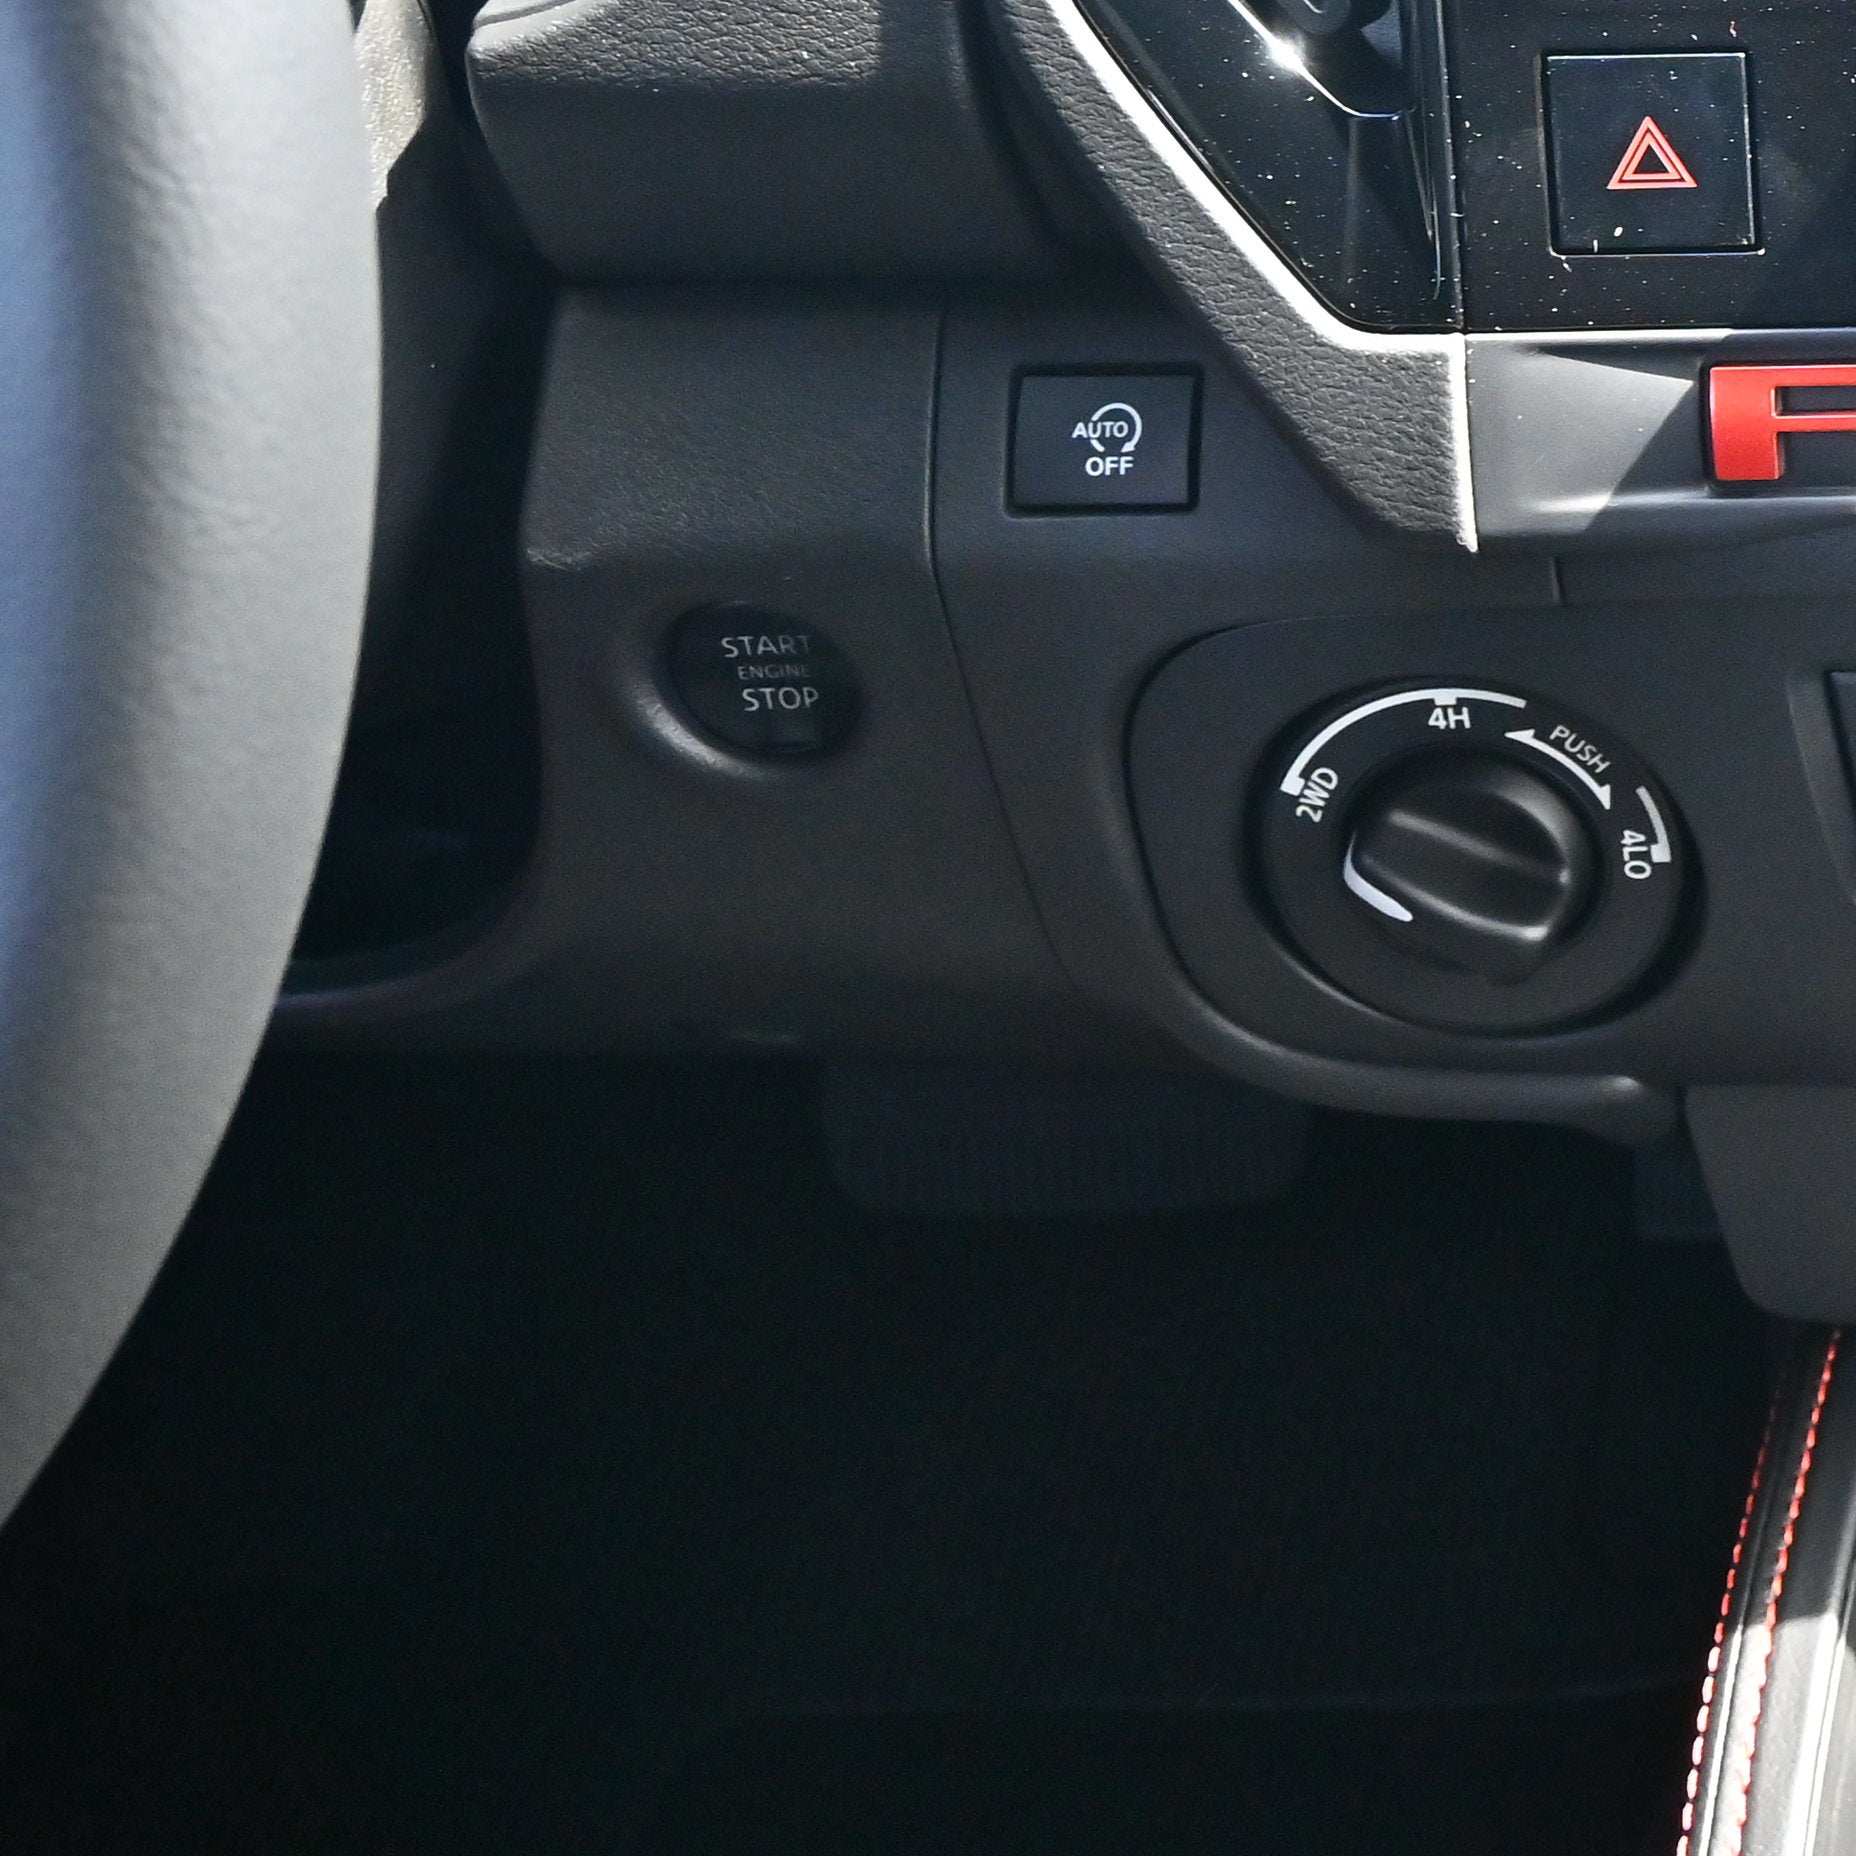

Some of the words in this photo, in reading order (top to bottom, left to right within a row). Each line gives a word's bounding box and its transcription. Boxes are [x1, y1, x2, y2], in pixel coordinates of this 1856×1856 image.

[1072, 420, 1129, 440] AUTO
[1085, 456, 1134, 477] OFF
[721, 634, 811, 659] START
[737, 664, 812, 681] ENGINE
[741, 686, 820, 712] STOP
[1428, 707, 1471, 730] 4H
[1549, 725, 1611, 774] PUSH
[1295, 766, 1339, 823] 2WD
[1620, 828, 1652, 880] 4LO
